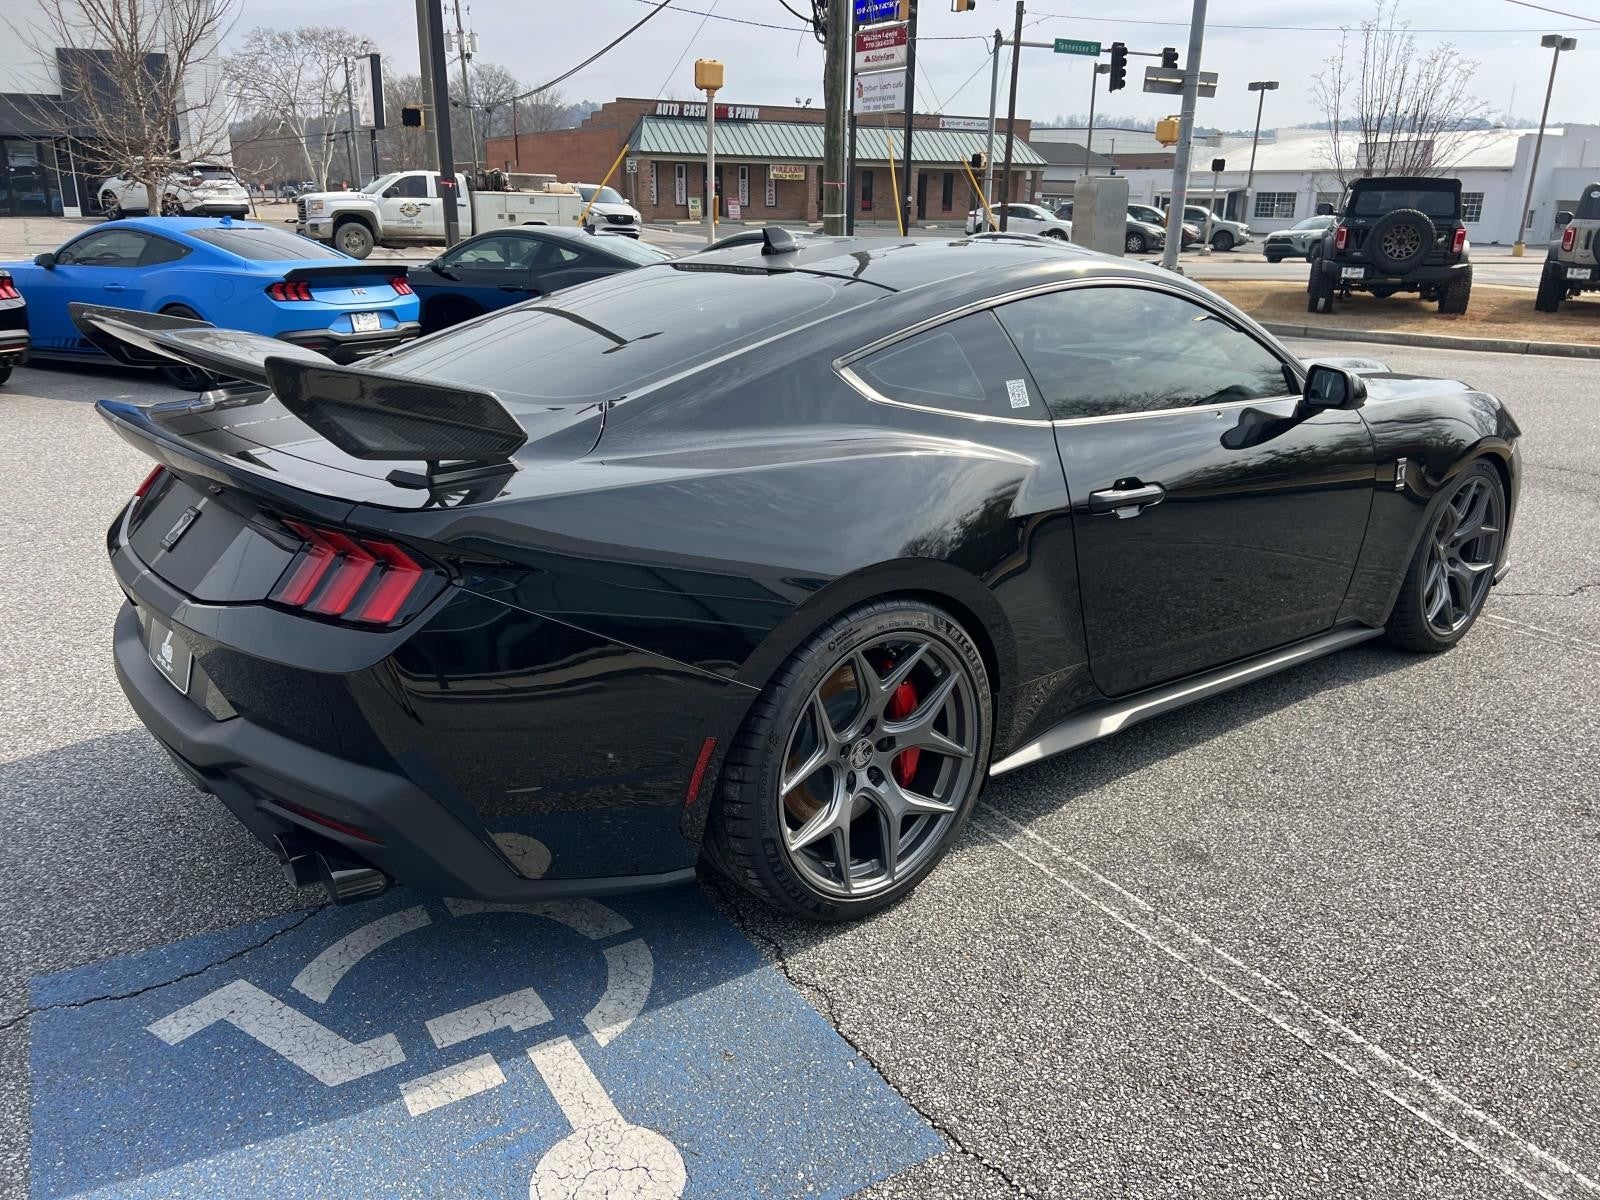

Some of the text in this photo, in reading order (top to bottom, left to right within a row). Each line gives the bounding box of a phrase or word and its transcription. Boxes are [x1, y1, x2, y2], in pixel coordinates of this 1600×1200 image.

[1058, 42, 1097, 53] Tennessee St
[656, 103, 760, 119] AUTO CASH & PAWN
[949, 626, 990, 701] MICHELIN
